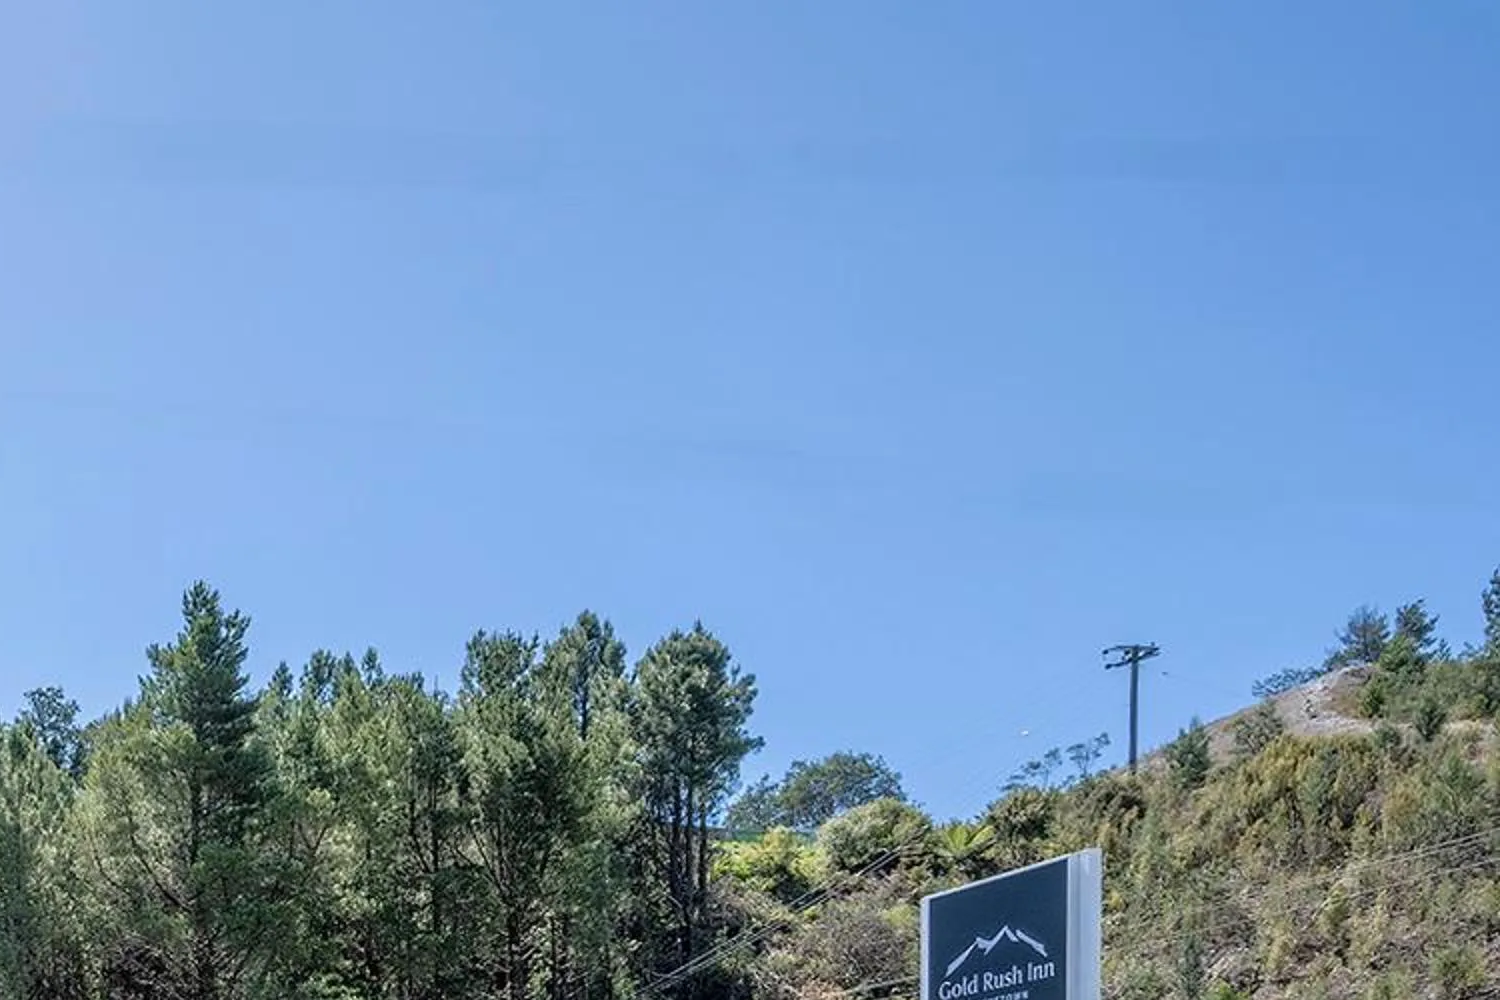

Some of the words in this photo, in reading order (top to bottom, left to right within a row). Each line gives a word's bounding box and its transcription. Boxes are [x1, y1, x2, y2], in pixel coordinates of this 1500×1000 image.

[939, 974, 978, 1000] Gold
[983, 965, 1023, 992] Rush
[1027, 962, 1055, 981] Inn
